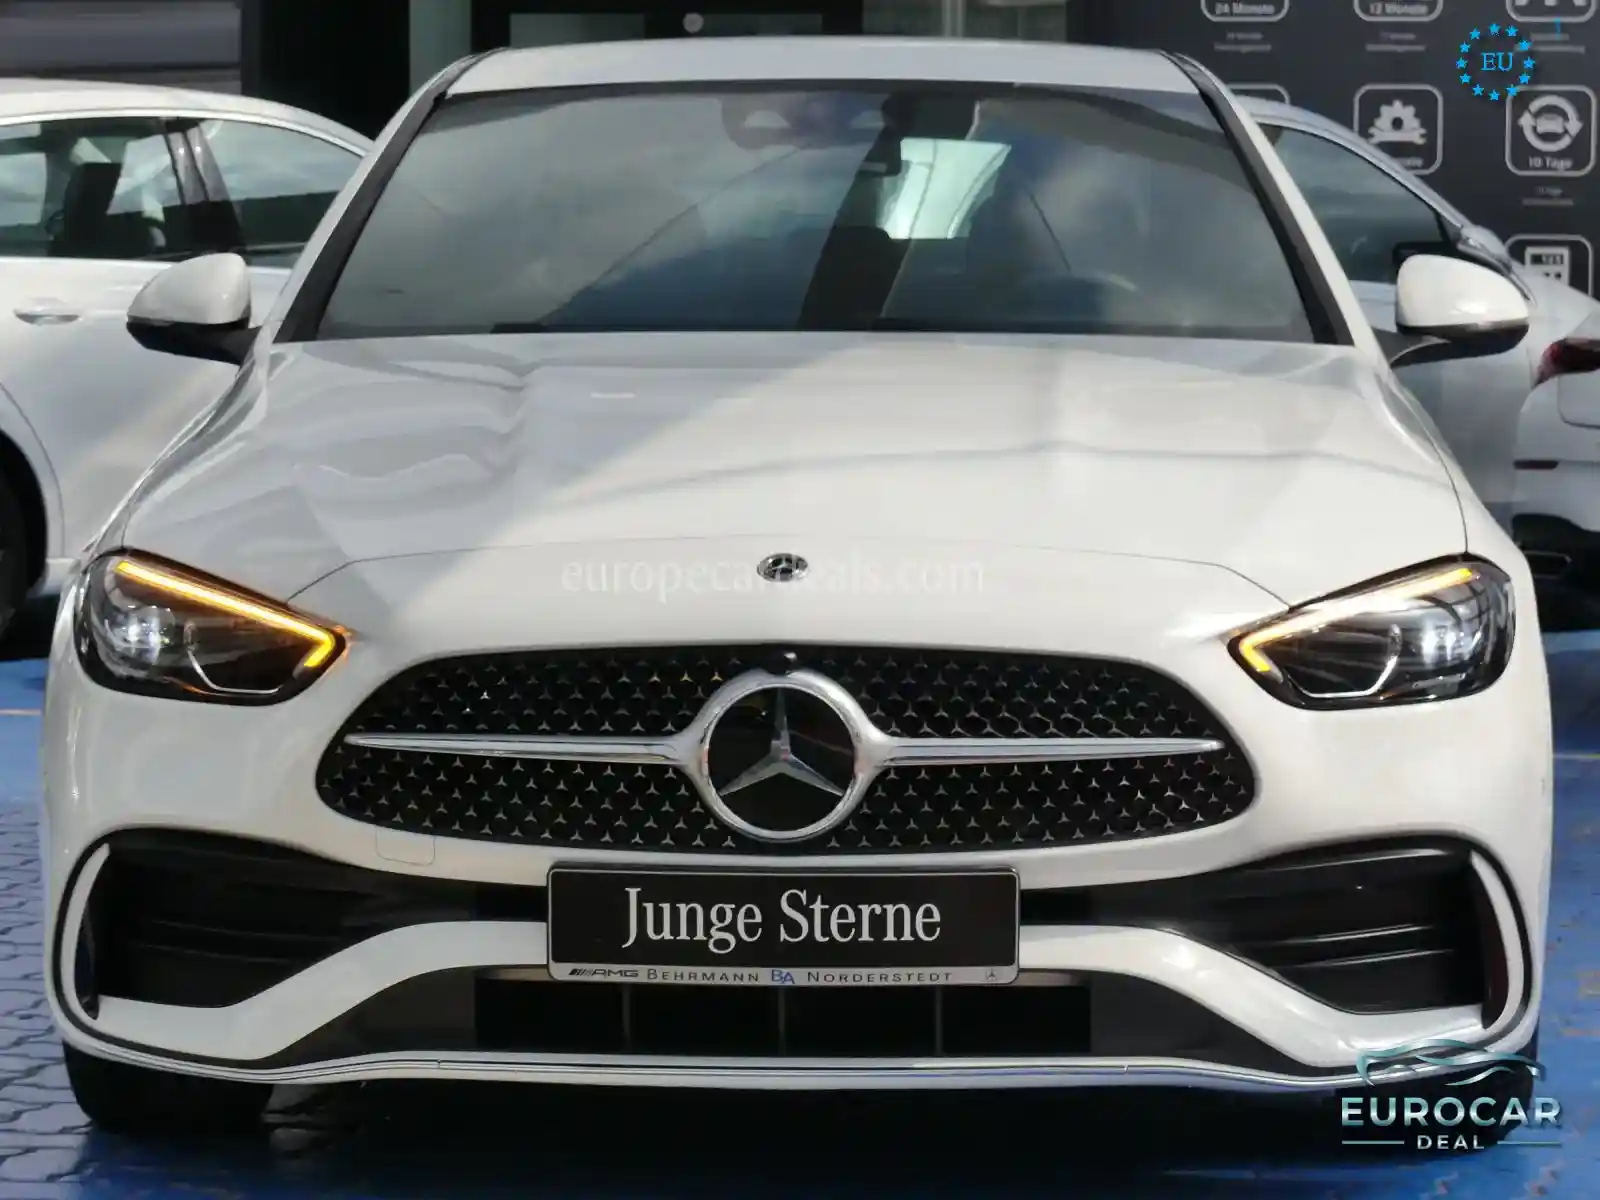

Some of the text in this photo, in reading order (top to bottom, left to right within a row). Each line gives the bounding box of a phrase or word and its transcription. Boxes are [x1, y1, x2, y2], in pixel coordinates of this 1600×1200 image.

[1544, 156, 1573, 171] Tage
[621, 887, 942, 954] Junge Sterne
[591, 969, 953, 984] AMG BEHRMANN BA NORDERSTEDT
